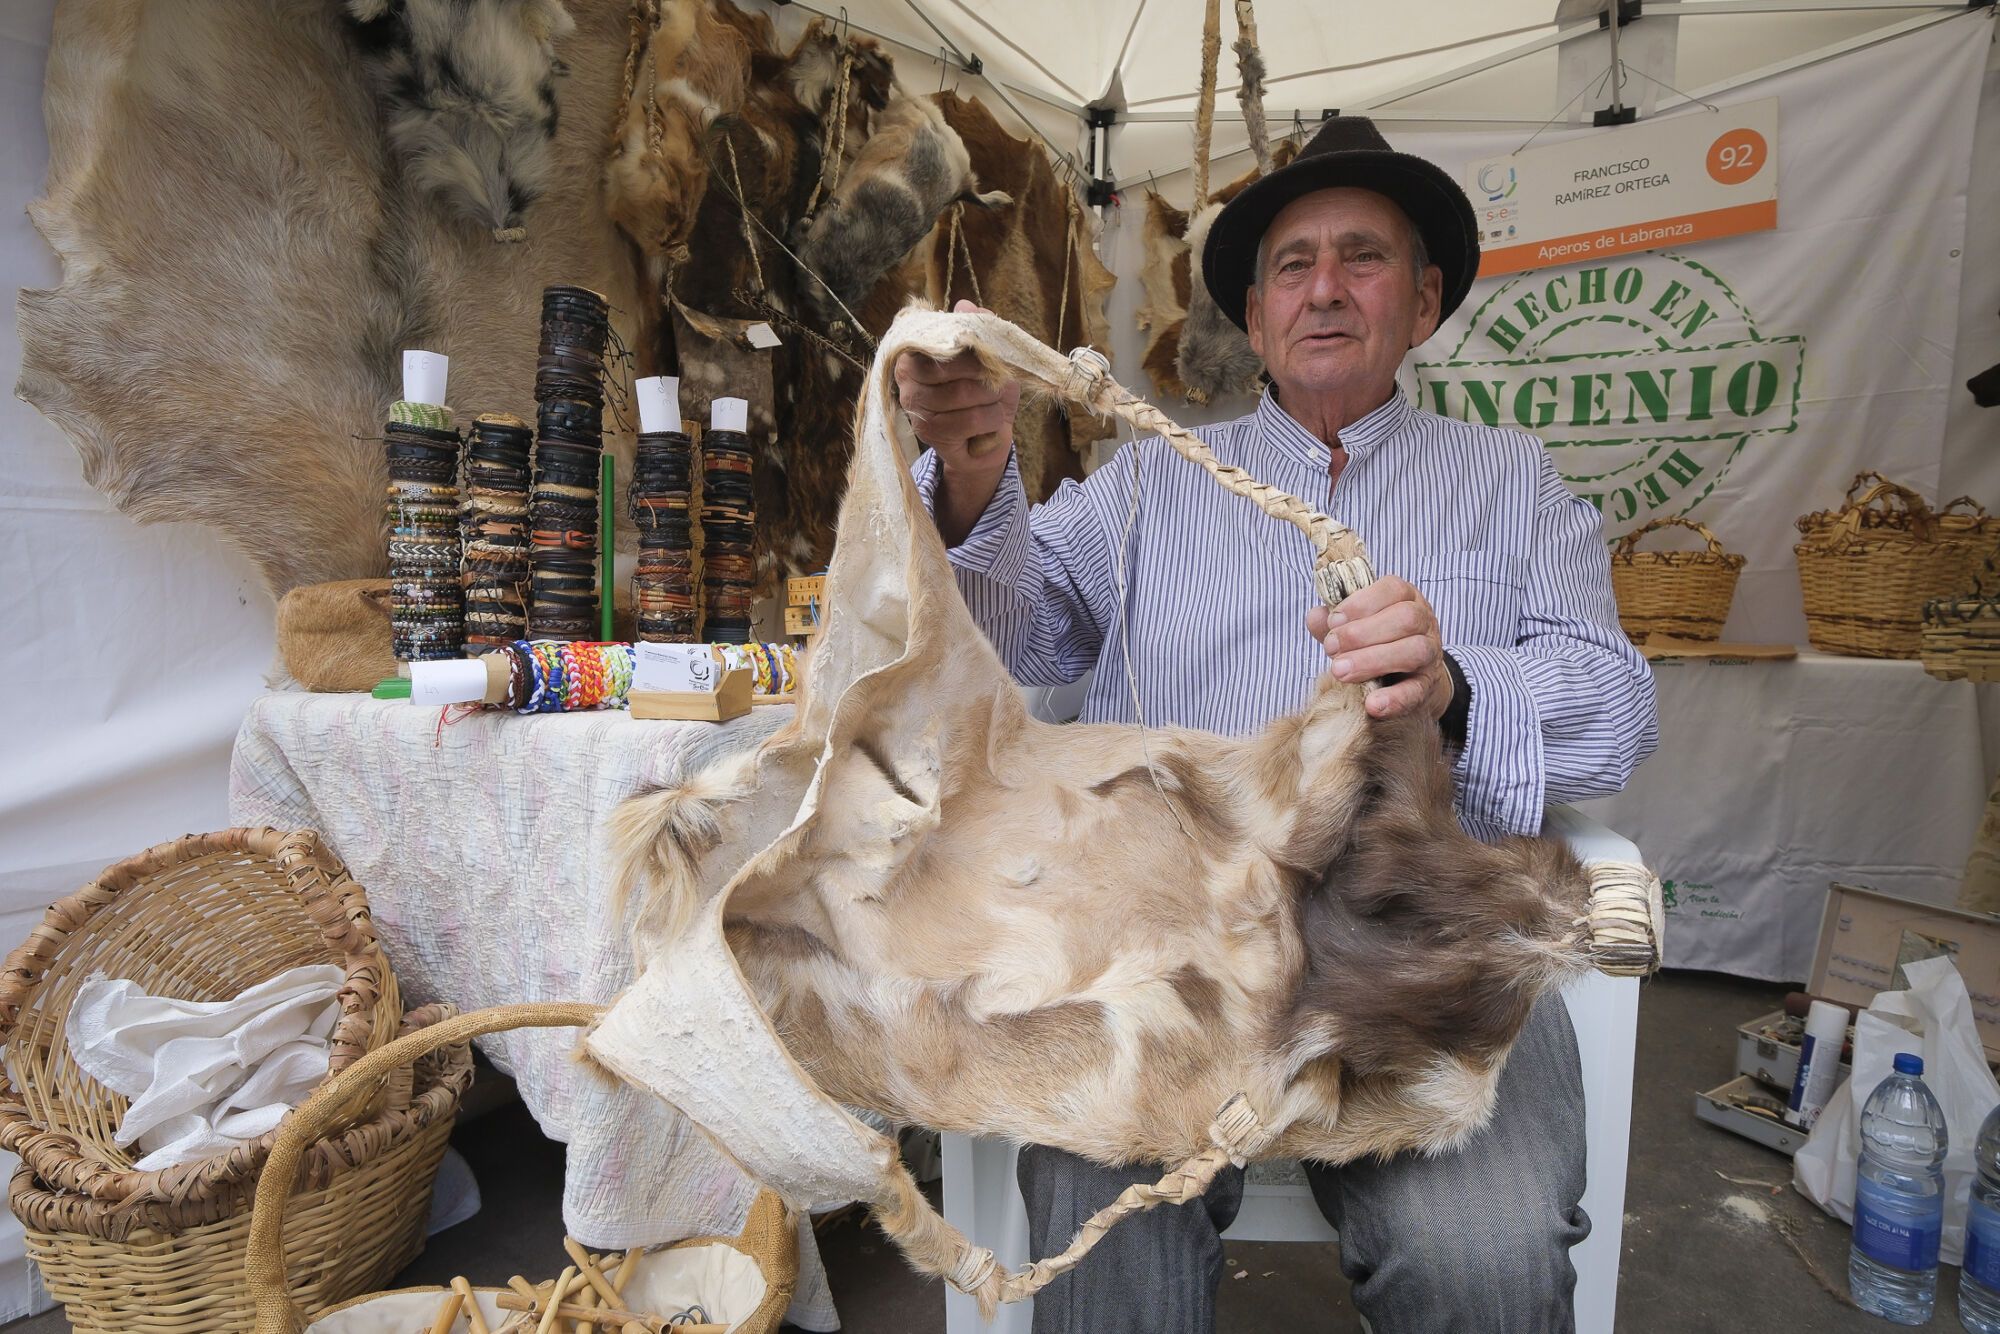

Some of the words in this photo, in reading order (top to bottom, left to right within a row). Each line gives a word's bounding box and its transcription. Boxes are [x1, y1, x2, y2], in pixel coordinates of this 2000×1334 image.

[1574, 158, 1650, 183] FRANCISCO
[1719, 144, 1753, 170] 92
[1615, 173, 1671, 194] ORTEGA
[1538, 239, 1590, 260] Aperos
[1595, 235, 1616, 249] de
[1620, 222, 1694, 246] Labranza
[1486, 266, 1644, 355] HECHO
[1650, 280, 1719, 340] EN
[1428, 360, 1778, 430] INGENIO
